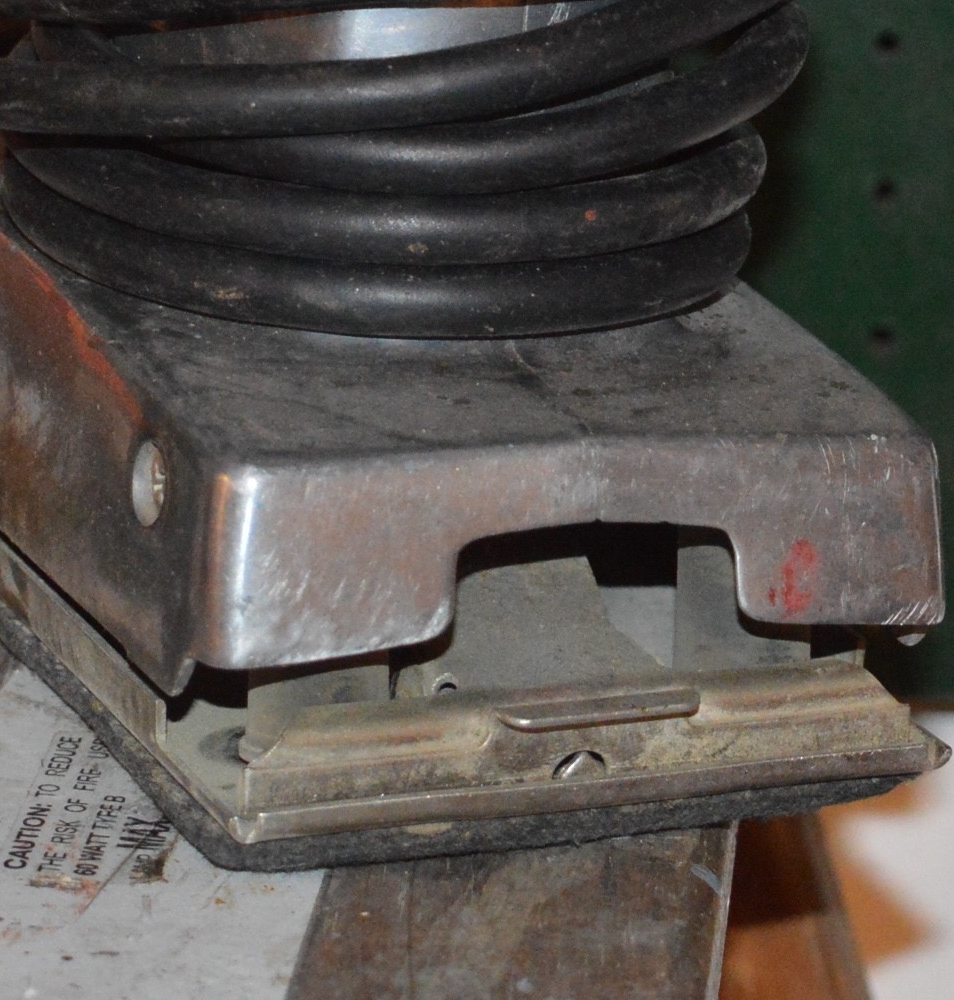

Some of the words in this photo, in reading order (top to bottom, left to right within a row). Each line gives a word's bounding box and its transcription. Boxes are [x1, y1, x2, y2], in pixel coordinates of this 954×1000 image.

[45, 736, 82, 778] REDUCE
[35, 783, 60, 798] TO
[73, 768, 102, 792] FIRE
[64, 798, 89, 813] OF
[104, 795, 126, 803] B
[3, 803, 53, 870] CAUTION:
[51, 819, 80, 845] RISK
[79, 832, 111, 863] WATT
[37, 852, 67, 872] THE
[74, 863, 99, 876] 60
